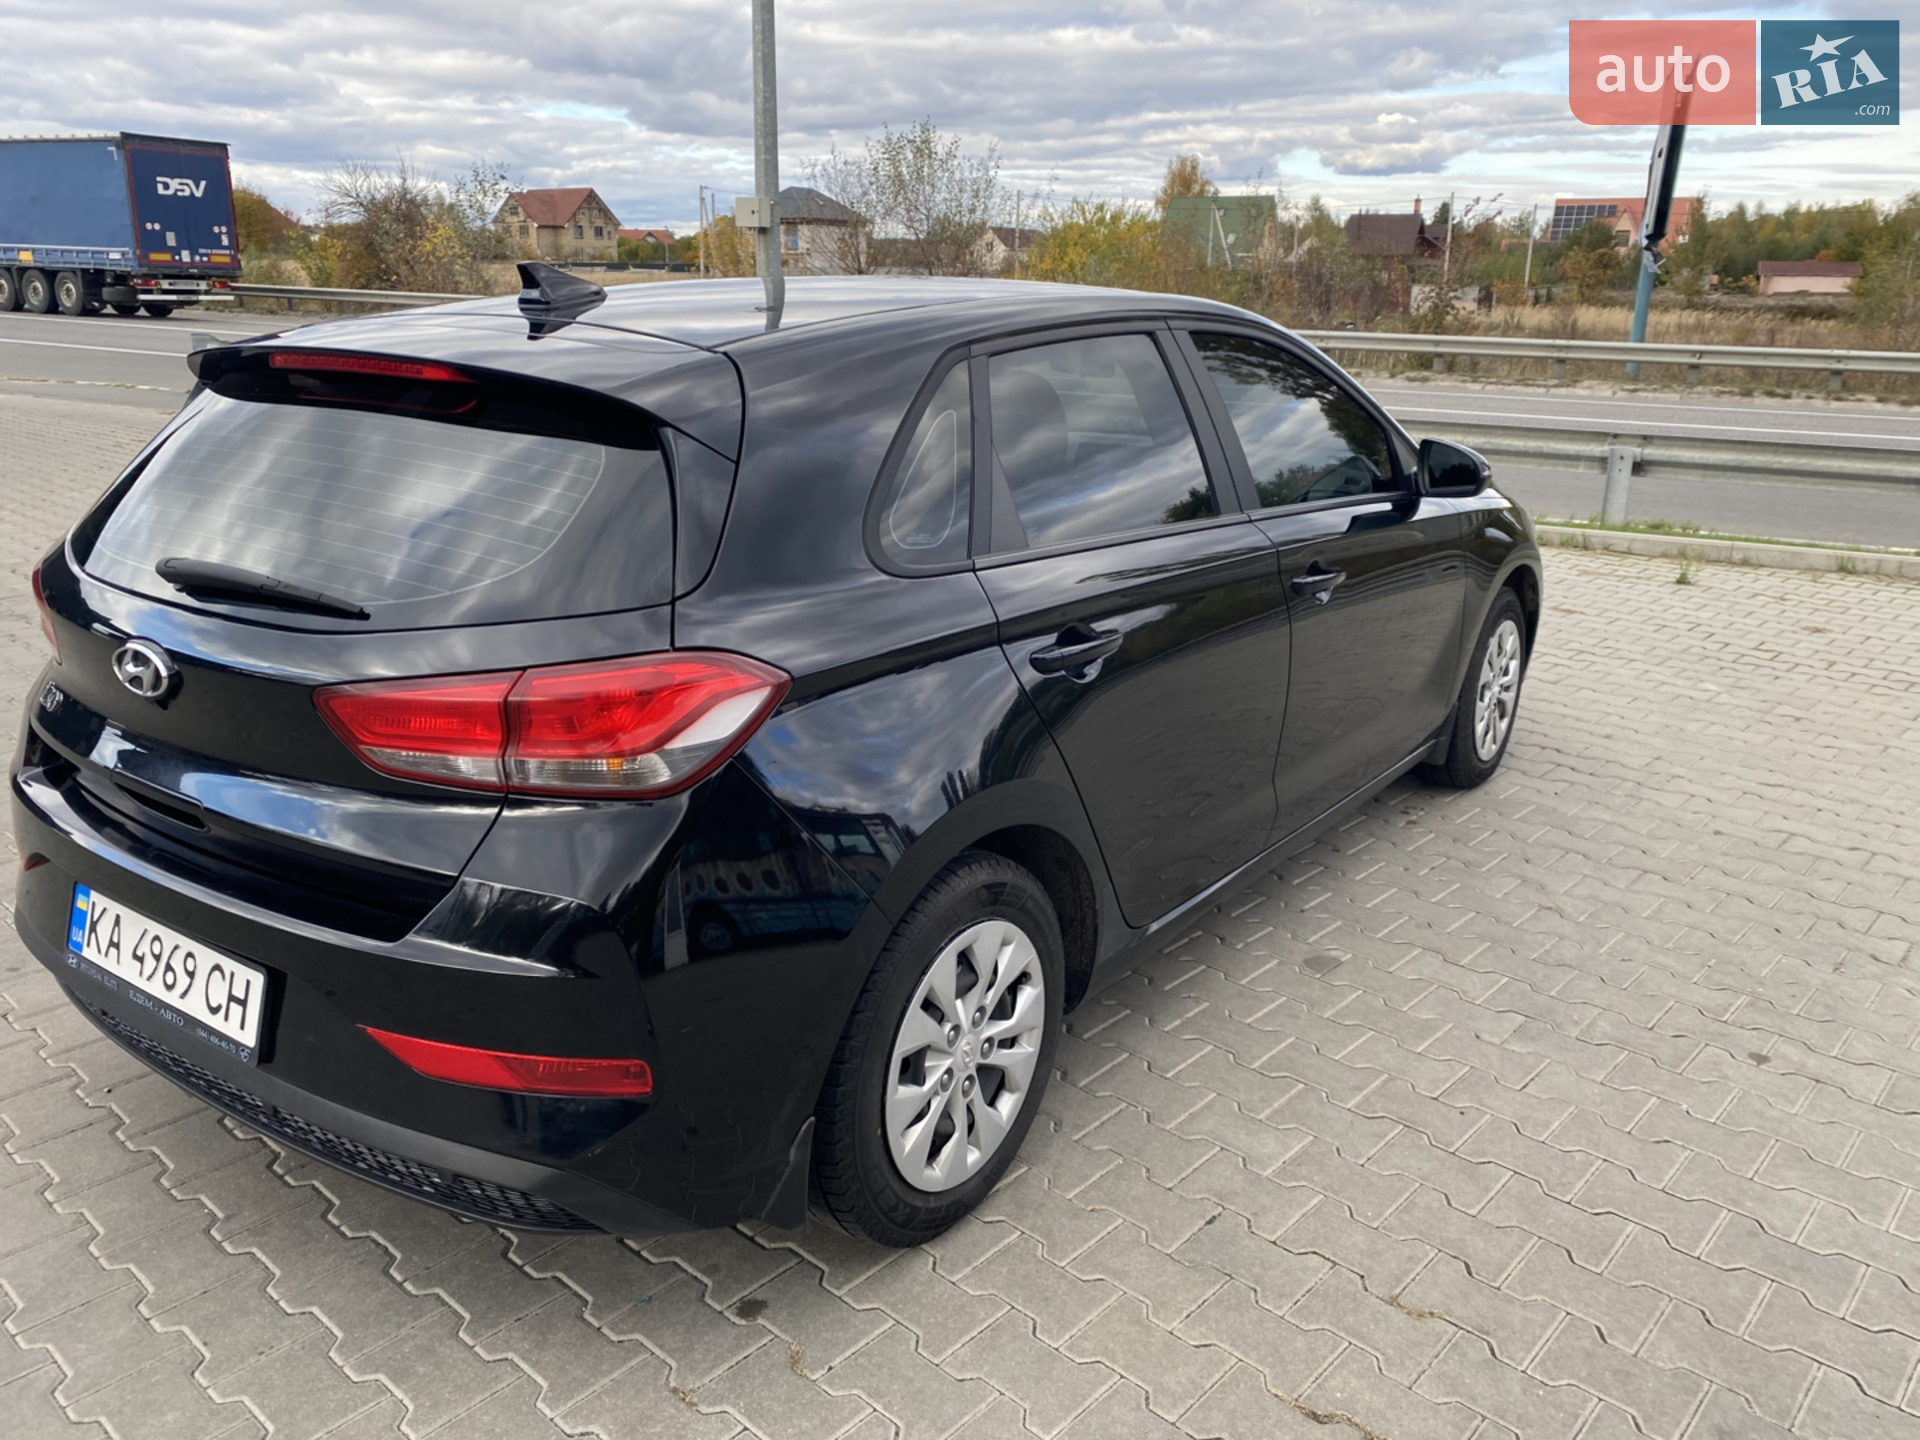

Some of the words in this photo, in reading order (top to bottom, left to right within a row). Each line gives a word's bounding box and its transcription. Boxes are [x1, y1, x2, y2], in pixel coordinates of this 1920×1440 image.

[156, 176, 206, 198] DSV
[71, 926, 83, 944] UA
[86, 900, 121, 965] KA
[131, 928, 197, 1000] 4969
[204, 962, 251, 1031] CH
